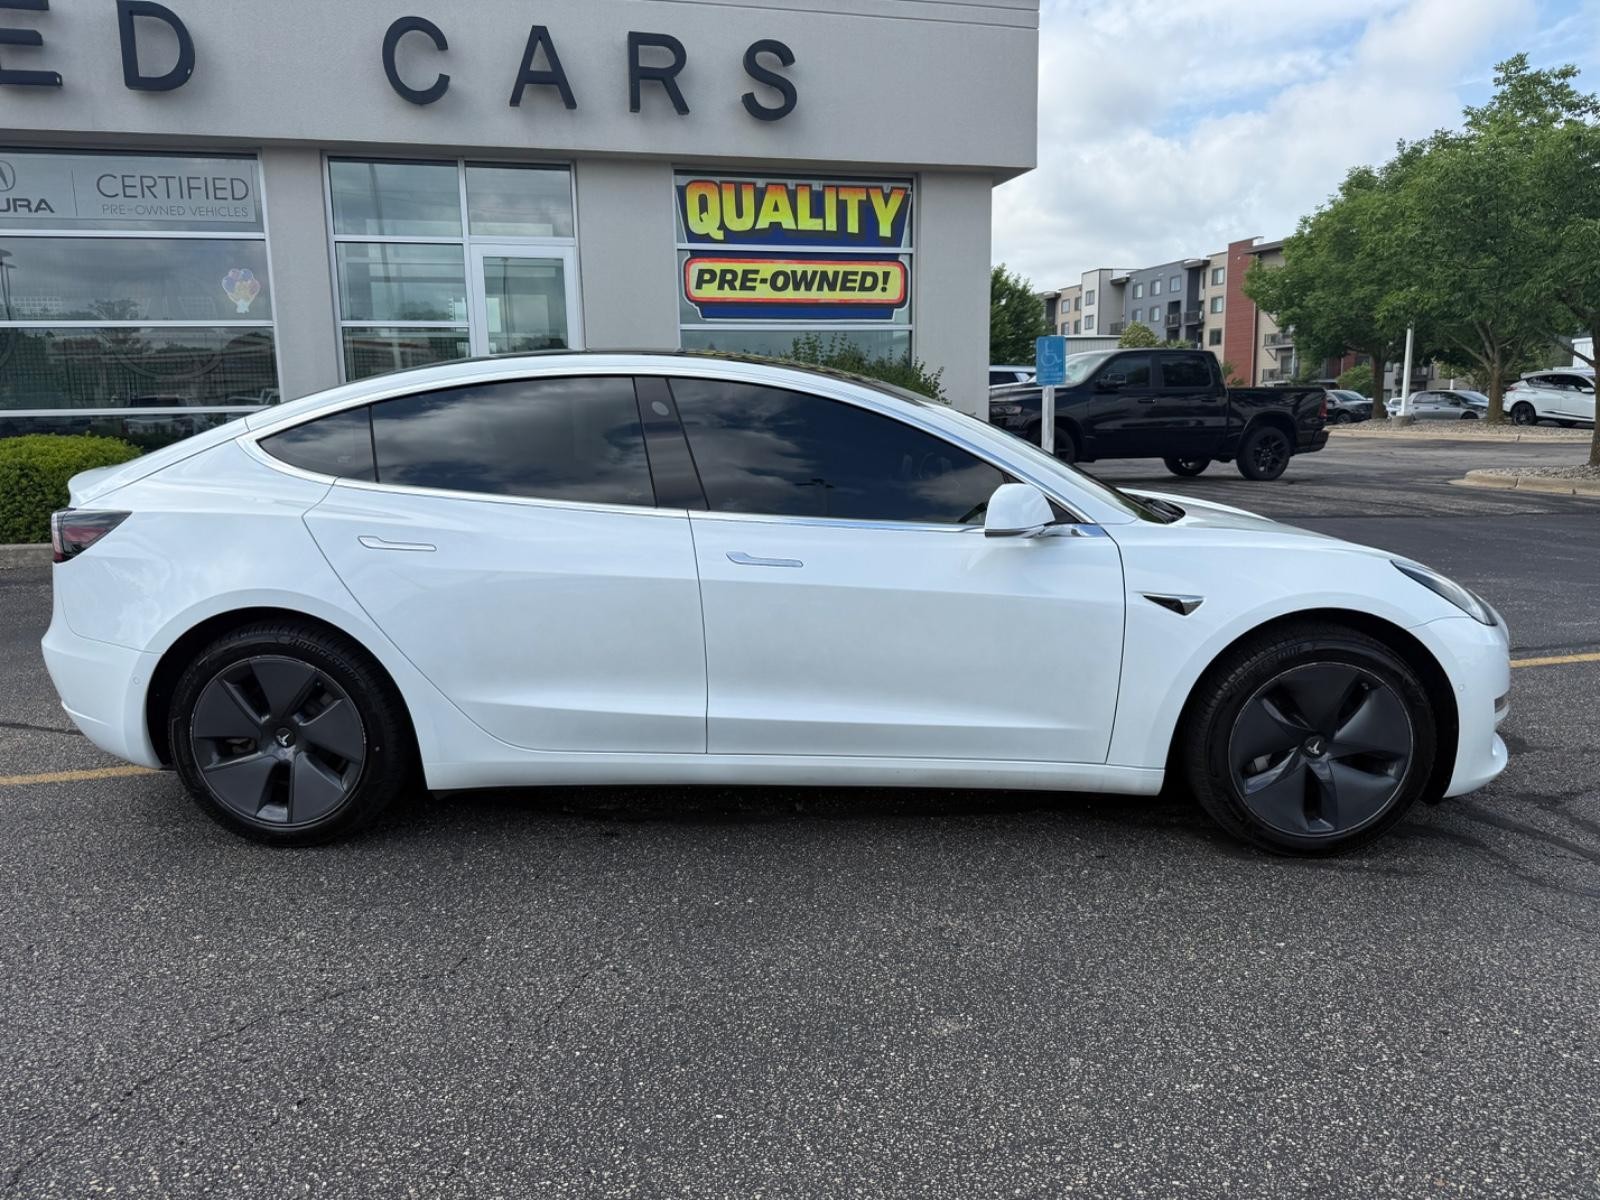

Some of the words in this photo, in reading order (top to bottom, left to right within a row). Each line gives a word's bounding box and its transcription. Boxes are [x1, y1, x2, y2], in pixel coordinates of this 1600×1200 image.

[382, 16, 798, 121] CARS
[96, 173, 250, 201] CERTIFIED
[101, 203, 186, 217] PRE-OWNED
[189, 205, 249, 218] VEHICLES
[686, 180, 908, 240] QUALITY
[695, 268, 891, 293] PRE-OWNED!
